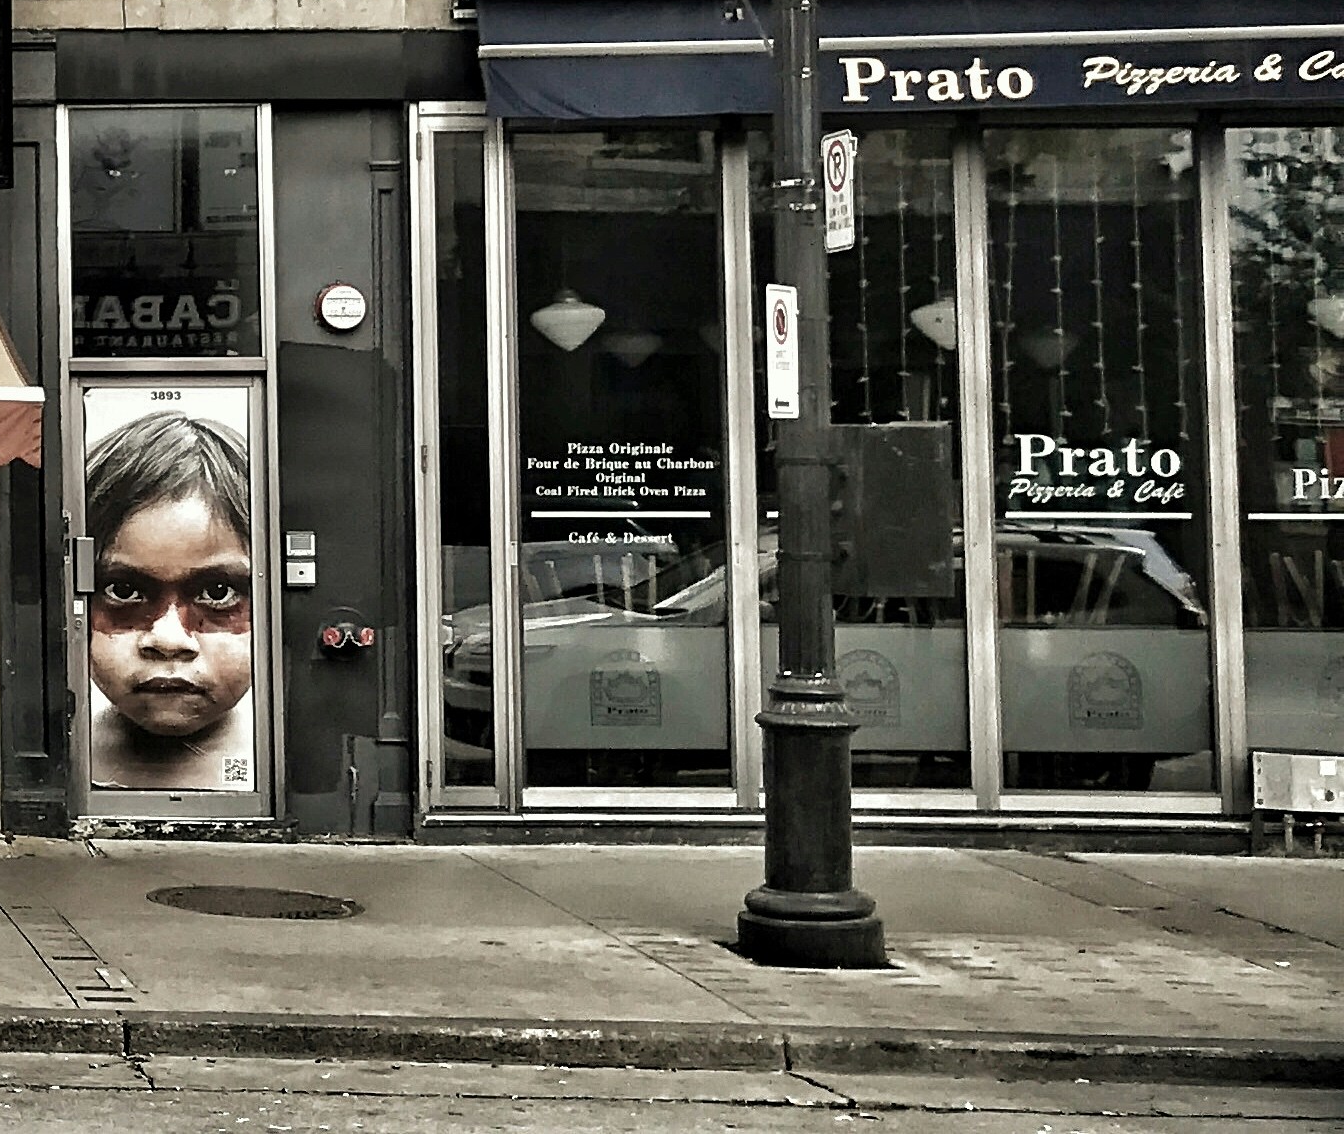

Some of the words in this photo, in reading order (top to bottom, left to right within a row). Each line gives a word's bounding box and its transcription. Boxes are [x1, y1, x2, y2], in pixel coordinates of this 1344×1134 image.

[839, 57, 1034, 102] Prato
[1082, 55, 1241, 96] Pizzeria
[1253, 53, 1282, 81] &
[150, 391, 182, 401] 3893
[567, 442, 604, 455] Pizza
[609, 442, 674, 456] Originale
[1013, 433, 1181, 478] Prato
[527, 458, 559, 470] Four
[564, 457, 580, 469] de
[585, 457, 630, 471] Brique
[634, 460, 652, 469] au
[656, 457, 714, 469] Charbon
[595, 472, 646, 484] Original
[535, 486, 562, 497] Coal
[567, 486, 598, 497] Fired
[603, 486, 636, 497] Brick
[640, 486, 669, 497] Oven
[674, 486, 707, 497] Pizza
[1008, 478, 1096, 504] Pizzeria
[1107, 480, 1124, 498] &
[1134, 479, 1185, 504] Café
[568, 531, 600, 544] Café
[605, 532, 617, 544] &
[623, 532, 673, 544] Dessert
